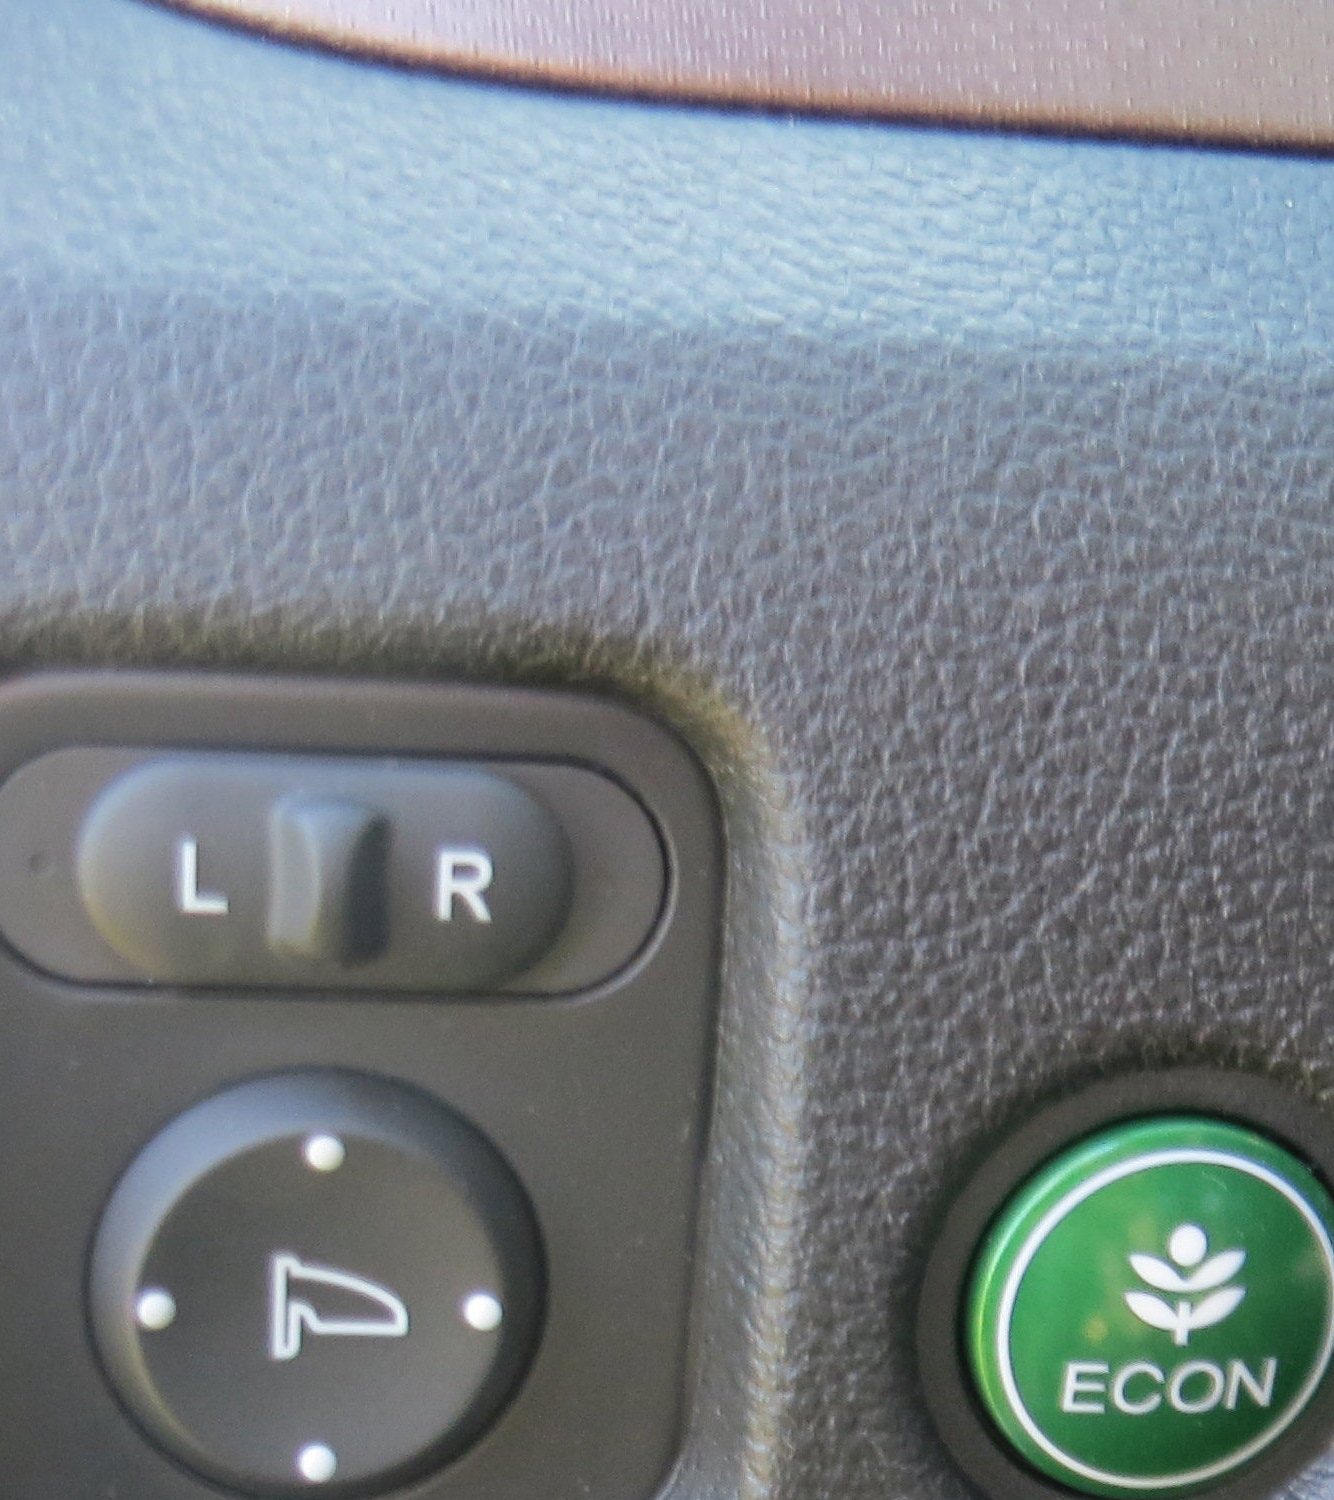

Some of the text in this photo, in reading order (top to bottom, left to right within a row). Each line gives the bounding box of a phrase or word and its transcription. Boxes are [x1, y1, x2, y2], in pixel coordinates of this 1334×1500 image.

[178, 842, 229, 915] L
[435, 848, 493, 922] R
[1060, 1358, 1277, 1415] ECON
